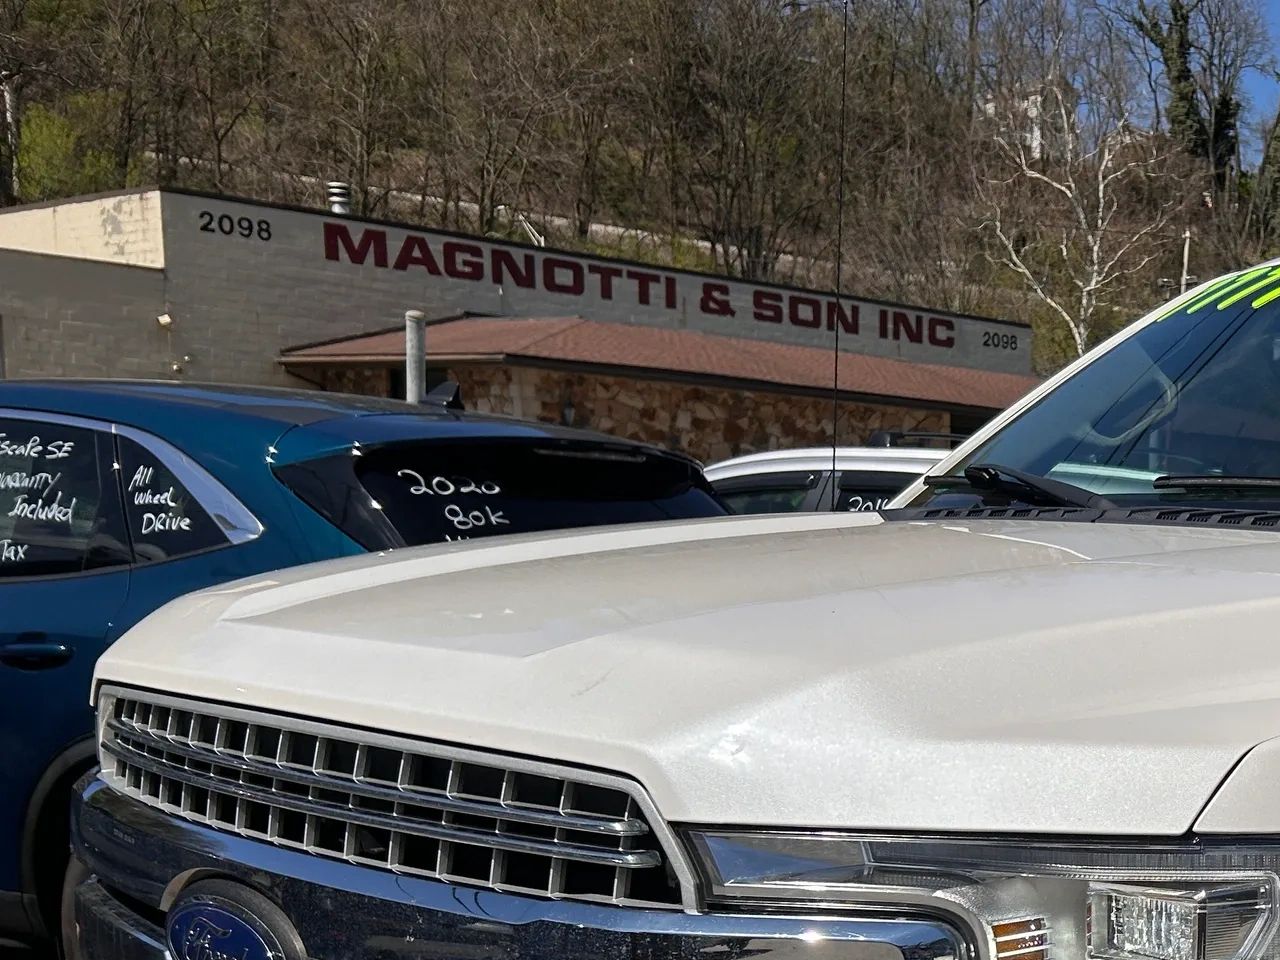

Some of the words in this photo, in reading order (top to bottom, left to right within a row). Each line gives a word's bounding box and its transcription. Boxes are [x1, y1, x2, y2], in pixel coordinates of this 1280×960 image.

[199, 210, 272, 241] 2098
[323, 222, 677, 309] MAGNOTTI
[700, 282, 736, 317] &
[753, 290, 859, 335] SON
[879, 308, 955, 348] INC
[982, 331, 1018, 350] 2098
[46, 440, 75, 459] SE
[128, 465, 153, 491] All
[397, 469, 500, 495] 2020
[8, 491, 76, 524] Included
[0, 539, 29, 561] Tax
